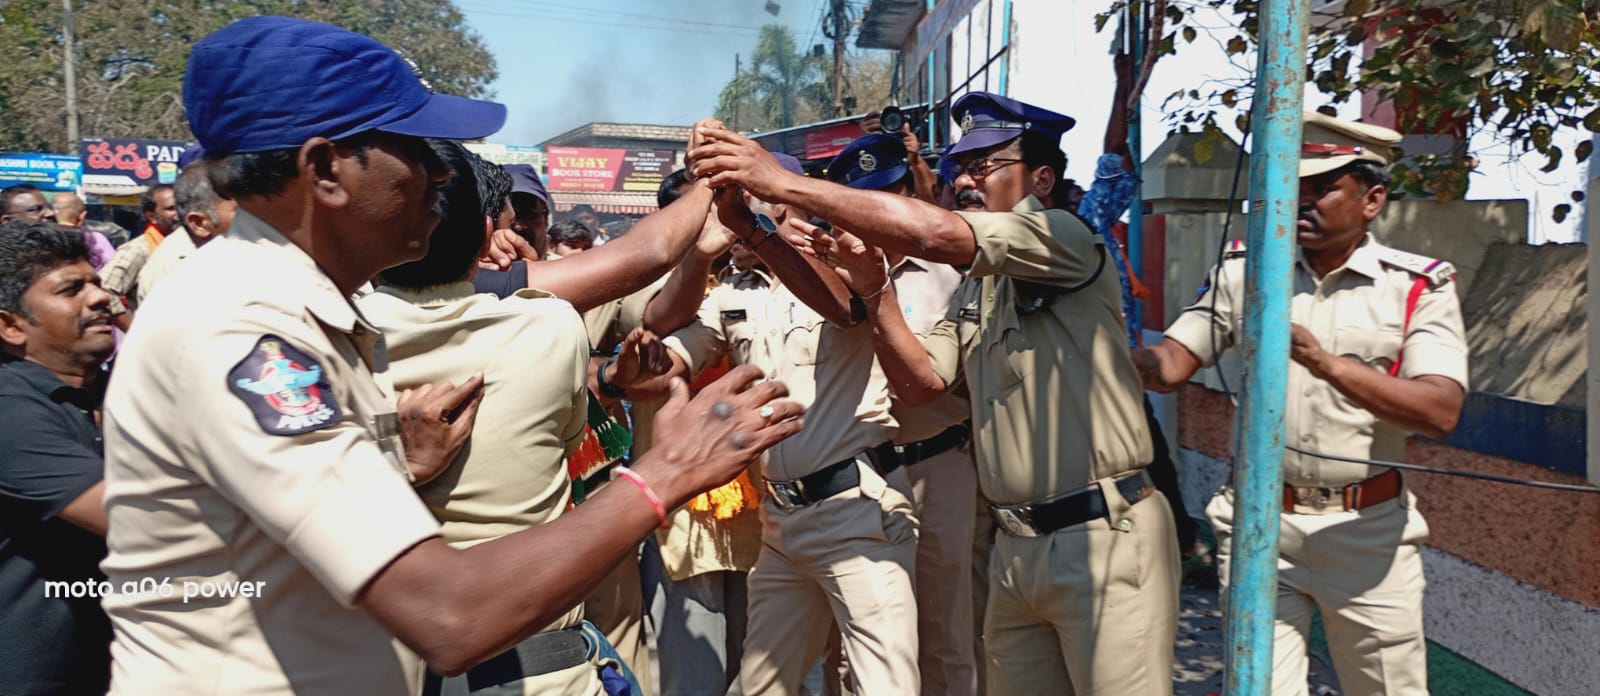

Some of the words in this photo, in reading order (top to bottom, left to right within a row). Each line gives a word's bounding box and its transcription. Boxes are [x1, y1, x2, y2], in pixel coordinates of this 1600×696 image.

[29, 159, 56, 169] BOOK
[57, 160, 81, 170] SHOP
[86, 141, 154, 180] పద్మ
[557, 156, 609, 169] VIJAY
[552, 168, 581, 177] BOOK
[582, 169, 614, 178] STORE
